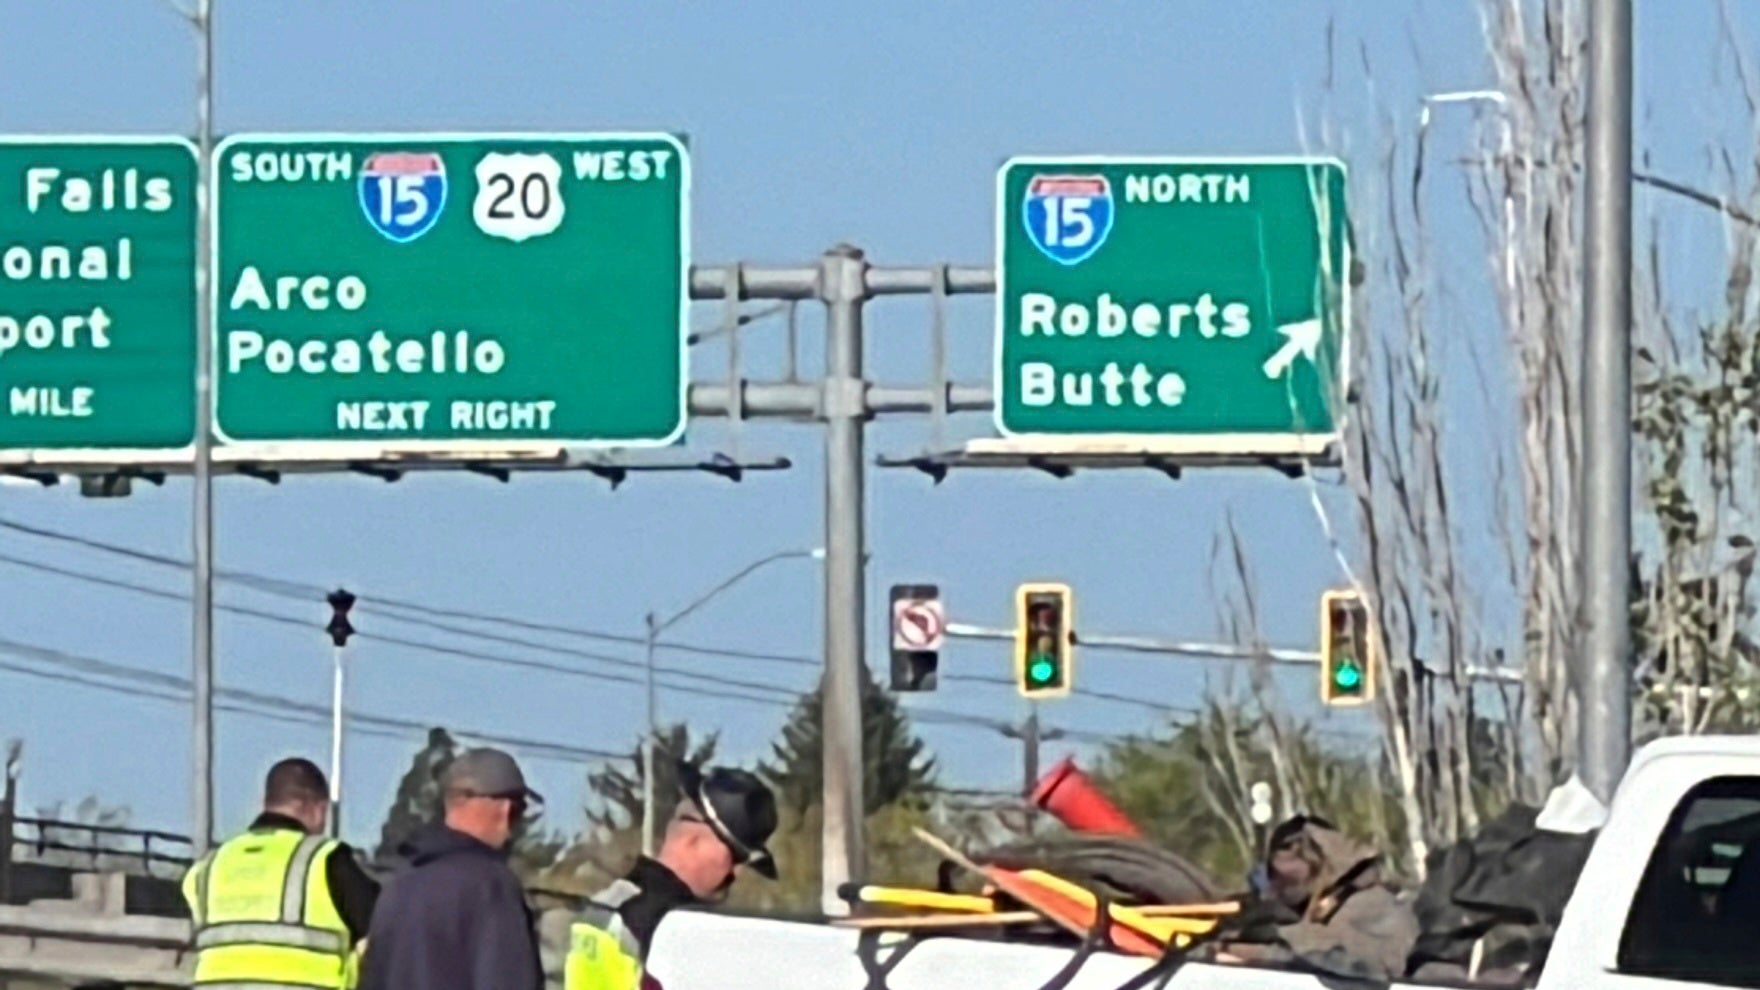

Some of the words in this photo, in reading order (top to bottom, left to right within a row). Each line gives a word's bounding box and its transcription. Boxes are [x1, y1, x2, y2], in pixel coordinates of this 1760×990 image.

[27, 168, 172, 213] Falls
[231, 152, 352, 182] SOUTH
[377, 176, 428, 226] 15
[487, 172, 550, 219] 20
[573, 151, 672, 181] WEST
[1043, 197, 1094, 247] 15
[1125, 174, 1250, 203] NORTH
[230, 266, 366, 310] Arco
[1020, 293, 1250, 337] Roberts
[228, 330, 505, 373] Pocatello
[10, 386, 94, 416] MILE
[1020, 362, 1186, 407] Butte
[337, 402, 430, 430] NEXT
[450, 402, 556, 430] RIGHT
